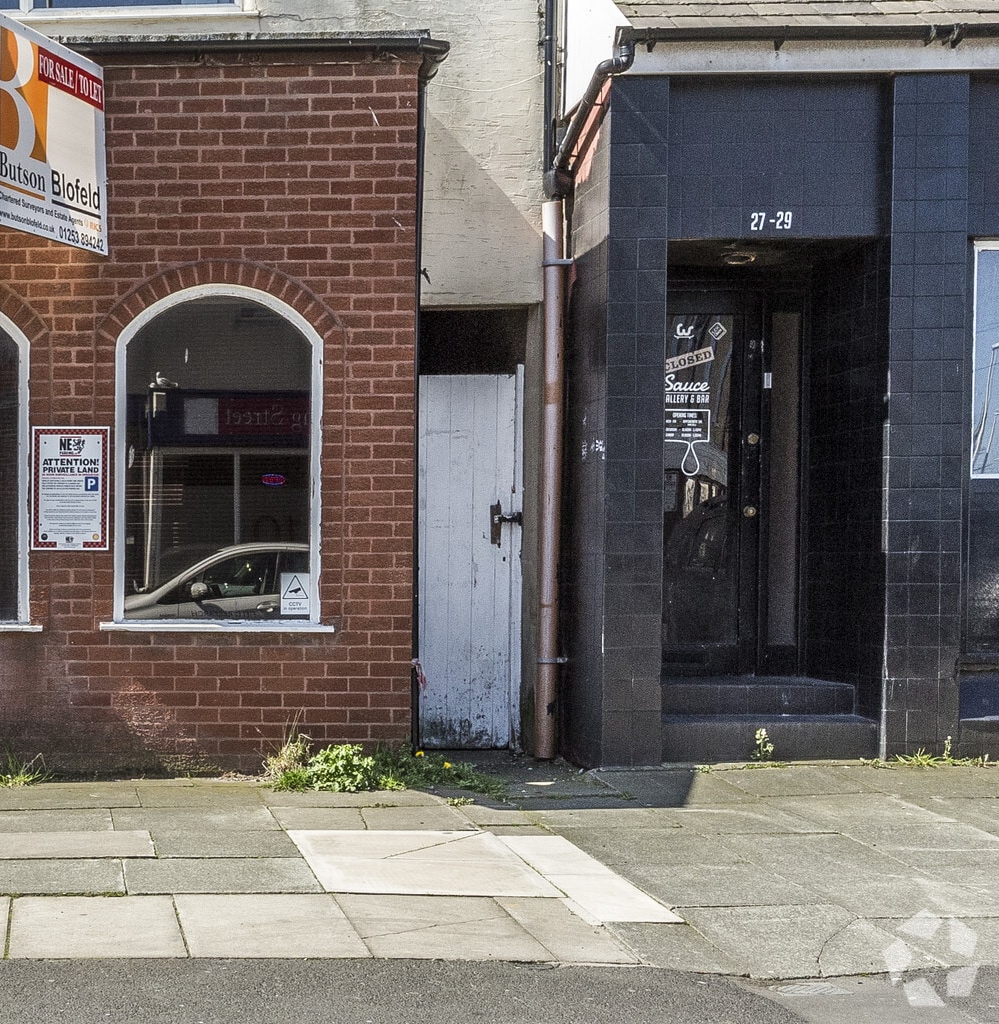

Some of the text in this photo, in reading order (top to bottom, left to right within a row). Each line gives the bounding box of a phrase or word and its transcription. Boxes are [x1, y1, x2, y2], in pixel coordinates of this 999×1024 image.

[39, 54, 54, 80] FOR
[54, 63, 74, 89] SALE
[79, 71, 89, 96] TO
[89, 77, 103, 104] LET
[51, 169, 101, 211] Blofeld
[21, 198, 45, 216] Surveyors
[45, 207, 54, 217] and
[54, 209, 68, 222] Estate
[68, 215, 83, 227] Agents
[89, 221, 103, 233] RICS
[58, 225, 80, 244] 01253
[80, 232, 105, 252] 894242
[665, 374, 710, 391] Sauce
[665, 394, 689, 404] ALLERY
[696, 395, 710, 404] BAR
[42, 458, 100, 466] ATTENTION!
[87, 478, 96, 490] P
